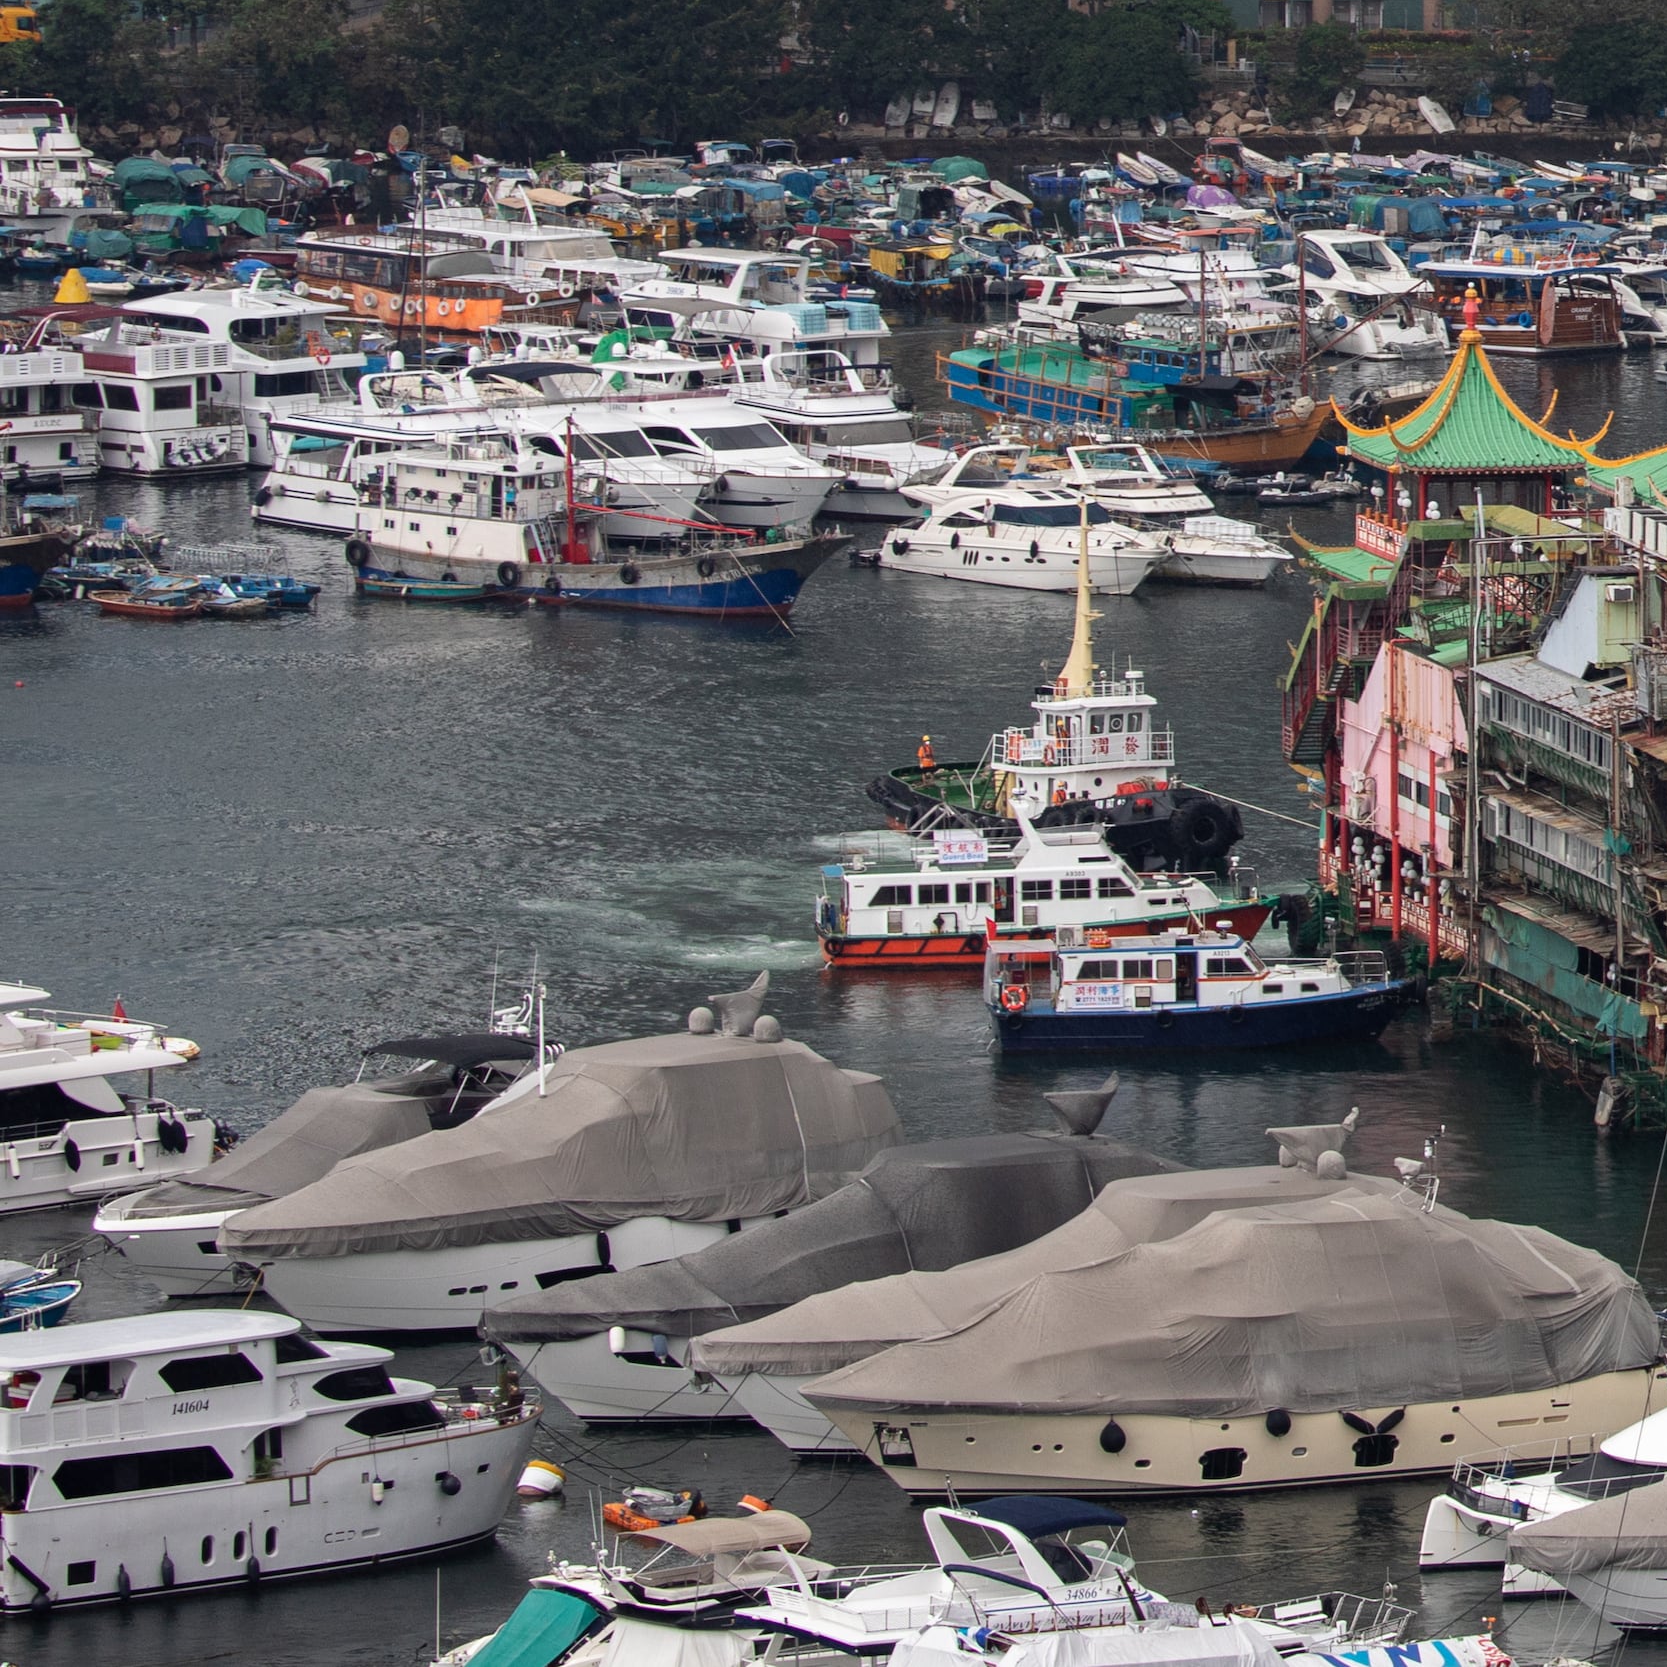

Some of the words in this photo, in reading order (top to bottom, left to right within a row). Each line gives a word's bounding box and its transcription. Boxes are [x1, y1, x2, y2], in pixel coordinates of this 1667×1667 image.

[1092, 736, 1140, 756] 潤發
[943, 853, 966, 861] Guard
[967, 852, 984, 860] Boat
[171, 1399, 210, 1415] 141604
[1064, 1587, 1098, 1601] 34866
